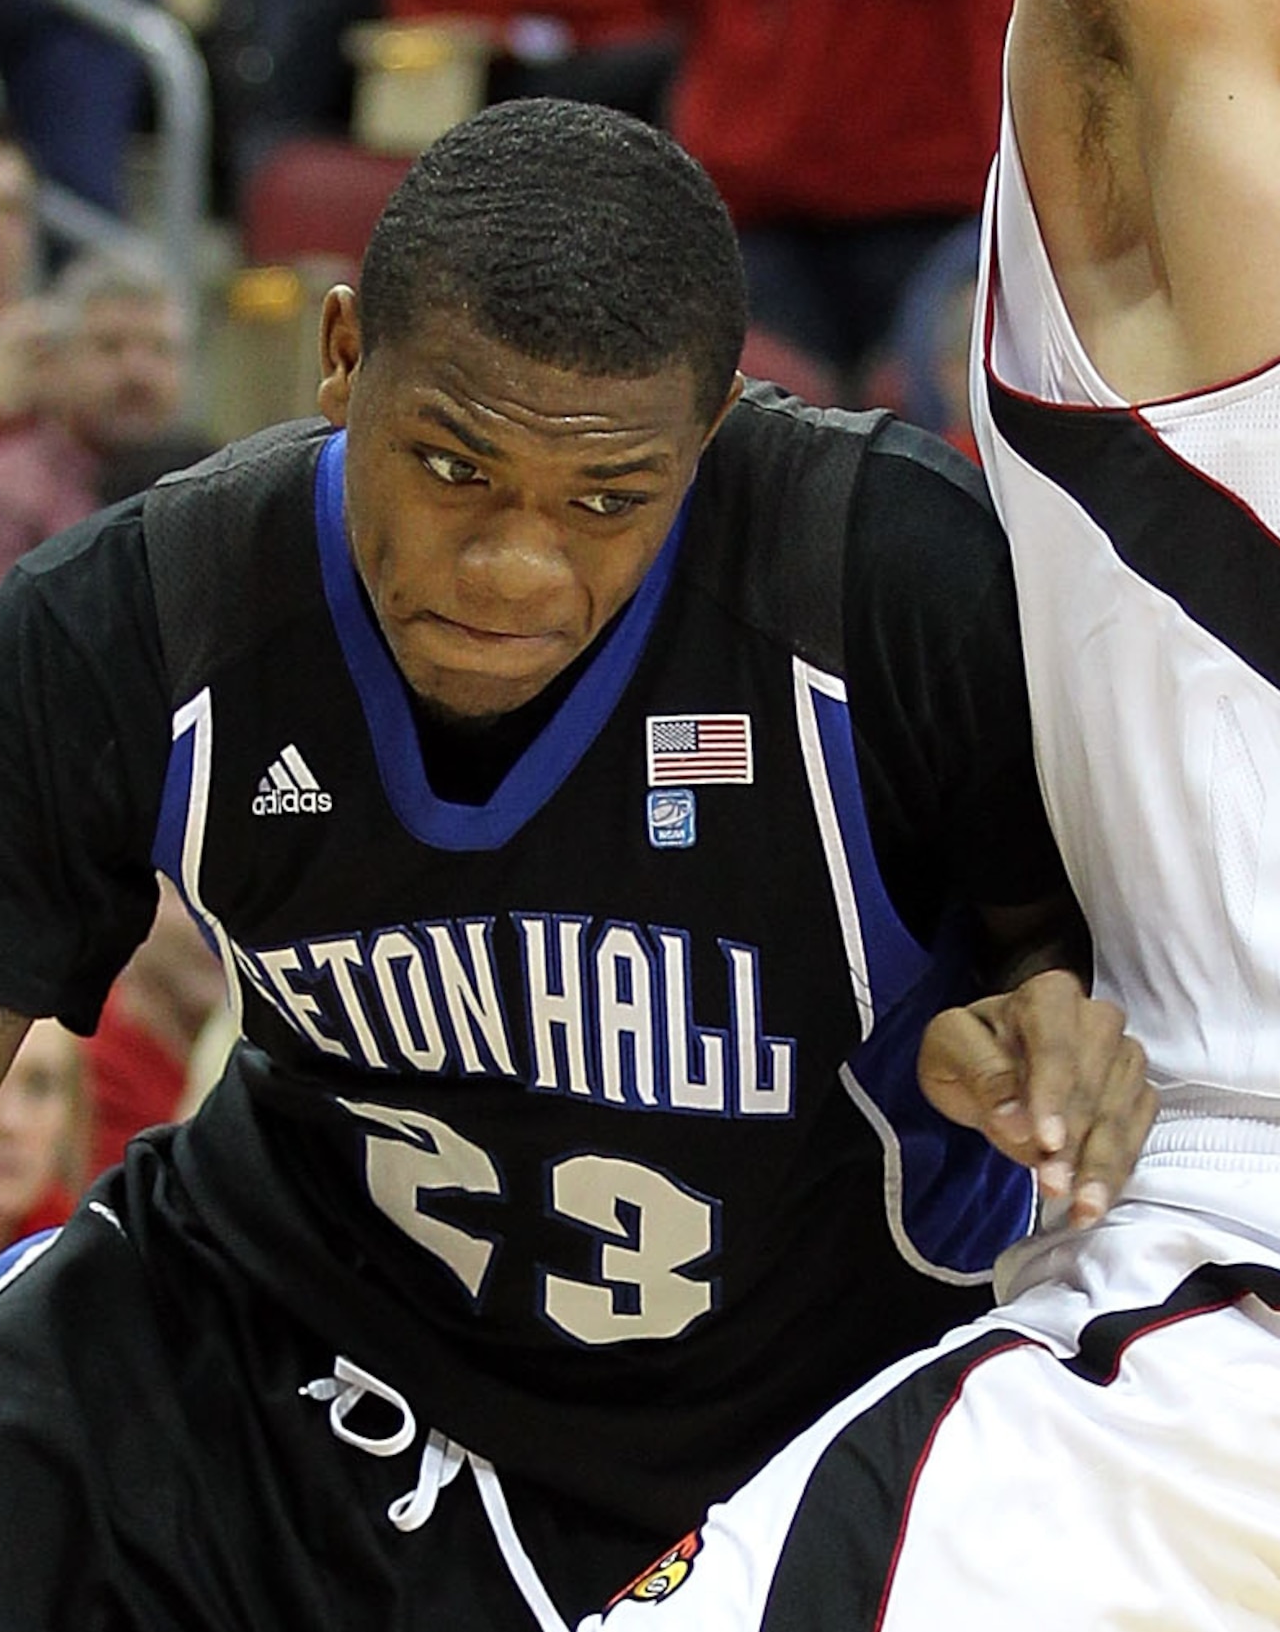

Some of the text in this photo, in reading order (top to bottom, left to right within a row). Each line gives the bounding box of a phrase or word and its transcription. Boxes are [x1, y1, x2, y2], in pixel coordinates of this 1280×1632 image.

[251, 787, 333, 816] adidas
[231, 911, 797, 1118] ETON HALL
[333, 1093, 723, 1349] 23
